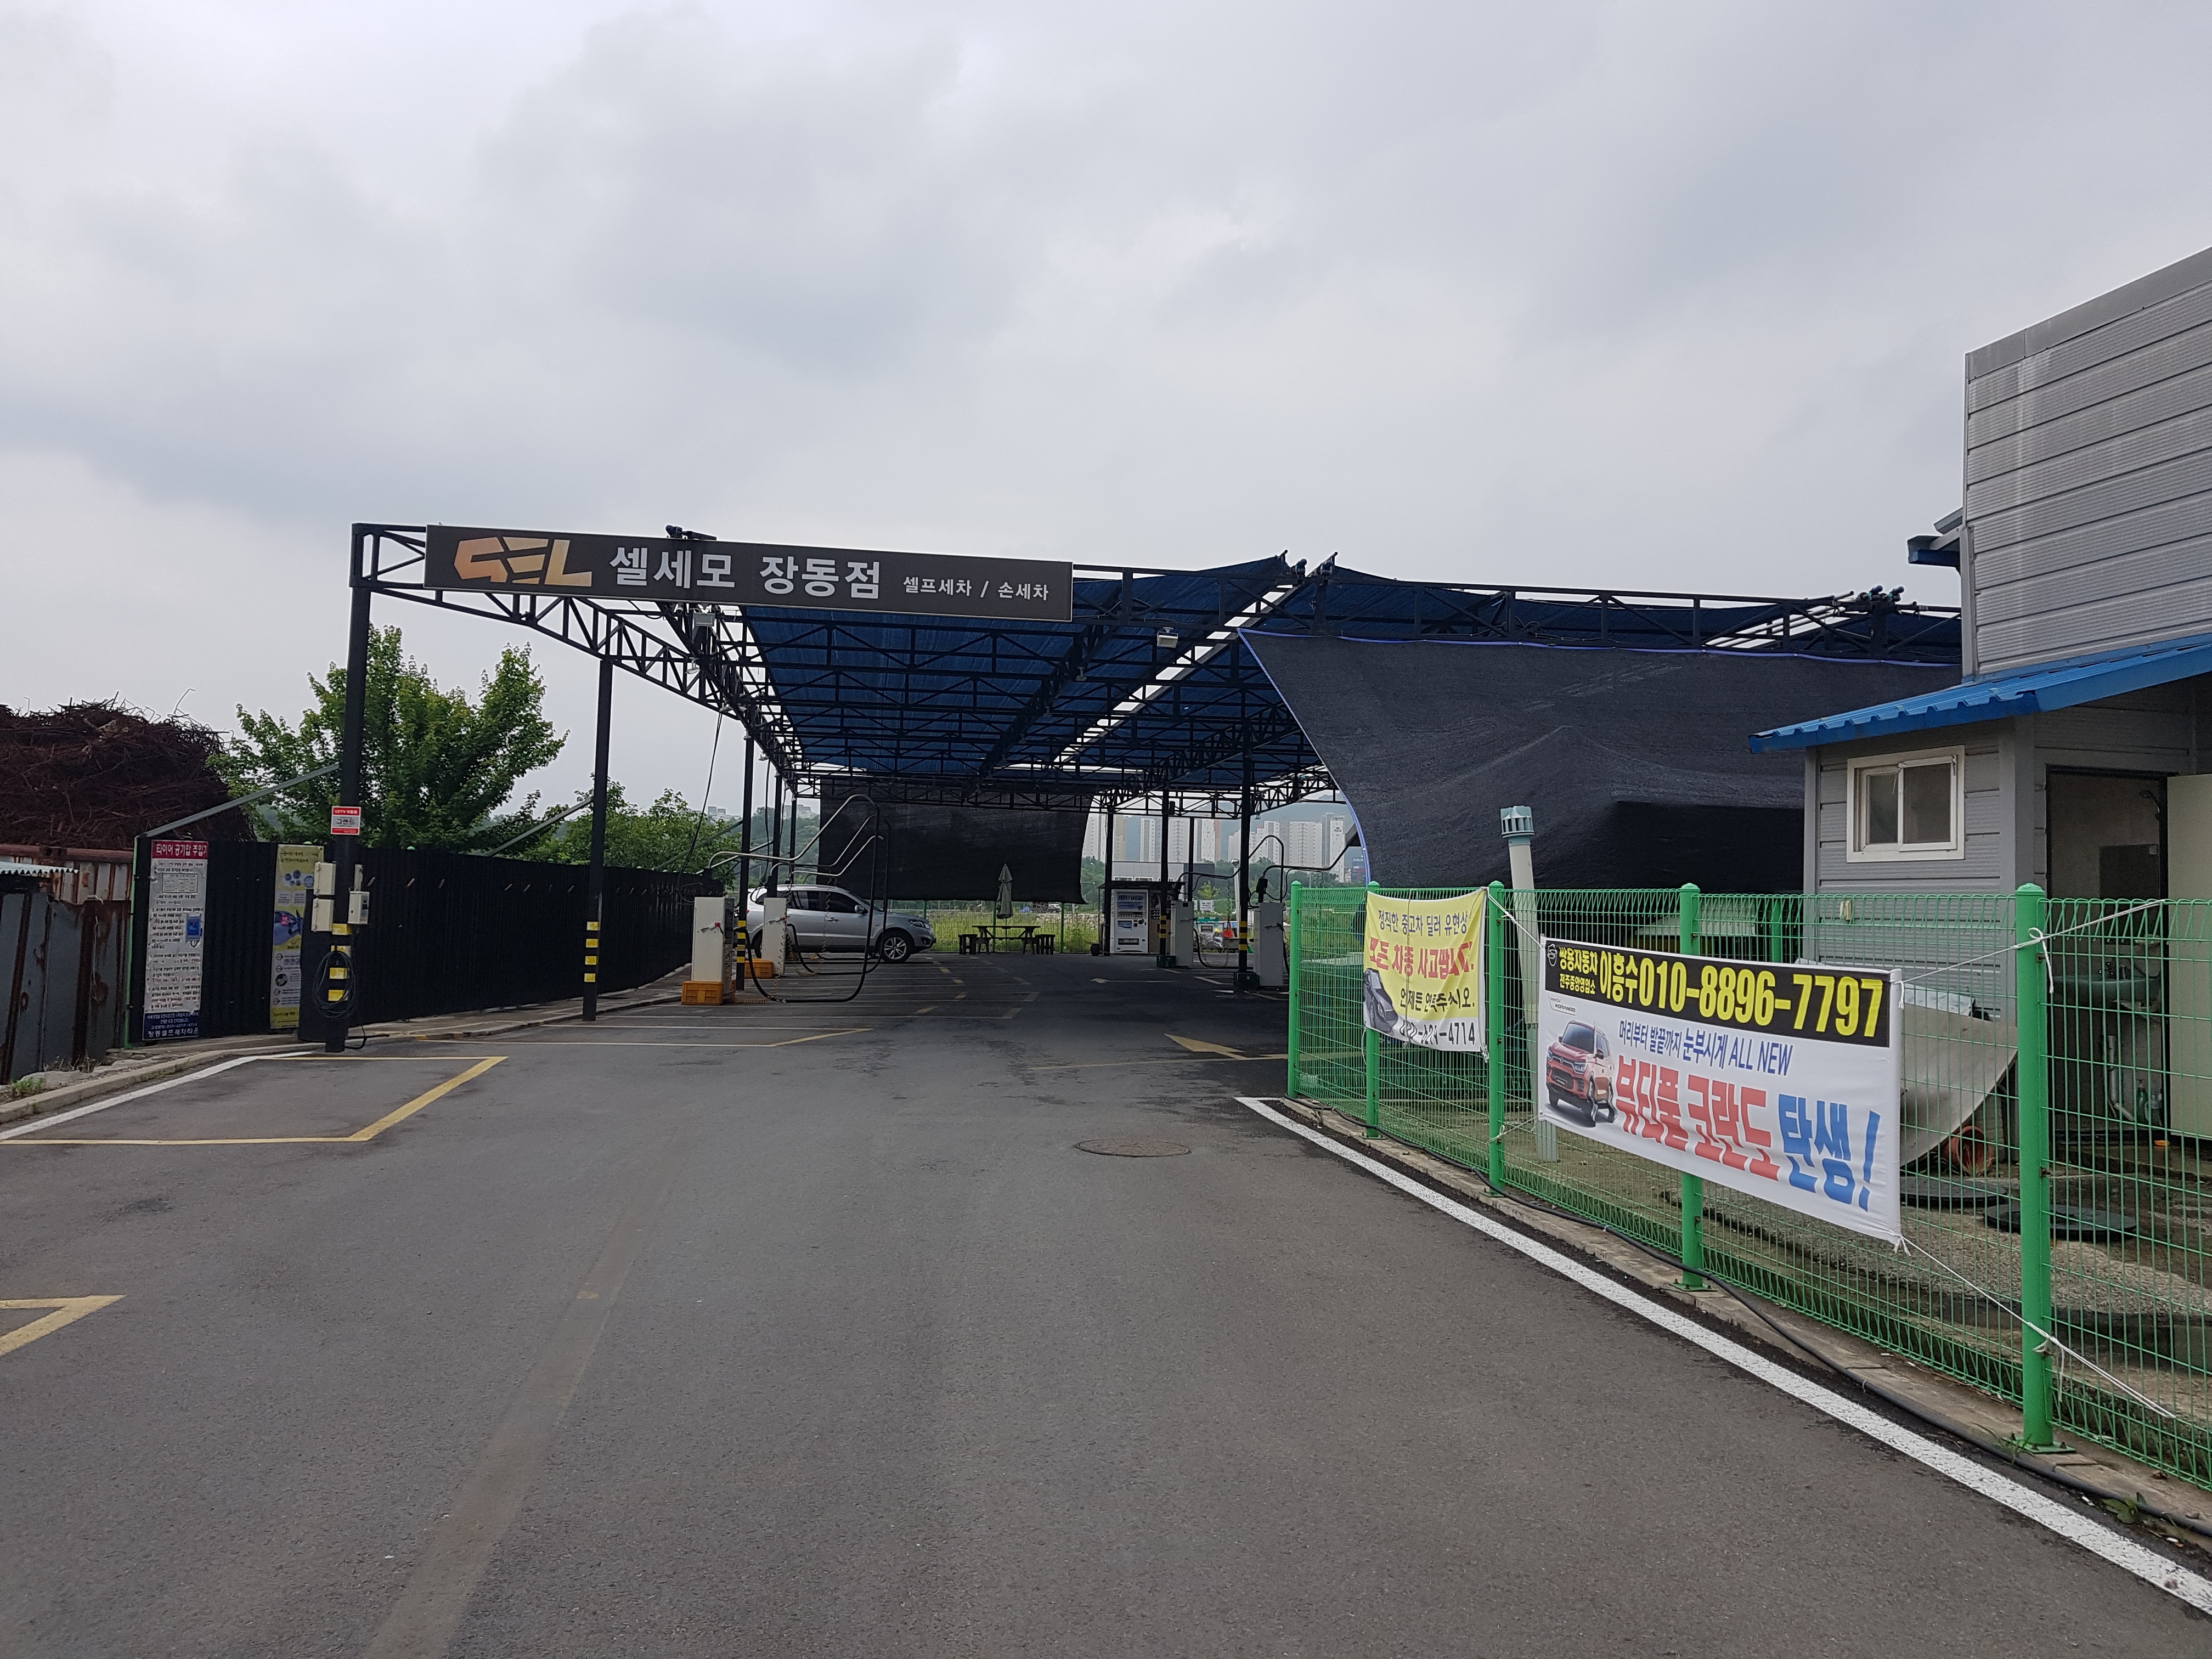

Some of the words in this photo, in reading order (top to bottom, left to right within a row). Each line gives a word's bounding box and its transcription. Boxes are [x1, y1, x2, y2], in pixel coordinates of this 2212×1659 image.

[610, 547, 735, 589] 셀세모
[759, 556, 879, 599] 장동점
[903, 576, 972, 597] 셀프세차
[998, 581, 1049, 601] 손세차
[156, 844, 173, 855] 타이어
[174, 844, 190, 856] 공기압
[1378, 910, 1398, 933] 정직한
[1402, 914, 1423, 936] 중고차
[1426, 915, 1441, 937] 딜러
[1444, 911, 1468, 936] 유현상
[1369, 937, 1389, 970] 모든
[1392, 944, 1413, 977] 차종
[1559, 947, 1598, 975] 쌍용자동차
[1560, 973, 1596, 995] 전주중앙영업소
[1600, 950, 1638, 1003] 이흥수
[1639, 958, 1883, 1037] 010-8896-7797
[1400, 988, 1423, 1011] 언제든
[1619, 1020, 1649, 1050] 머리부터
[1650, 1026, 1683, 1058] 발끝까지
[1683, 1028, 1728, 1069] 눈부시게
[1728, 1036, 1753, 1070] ALL
[1757, 1041, 1793, 1076] NEW
[1688, 1074, 1780, 1181] 코란도
[1779, 1093, 1881, 1212] 탄생!
